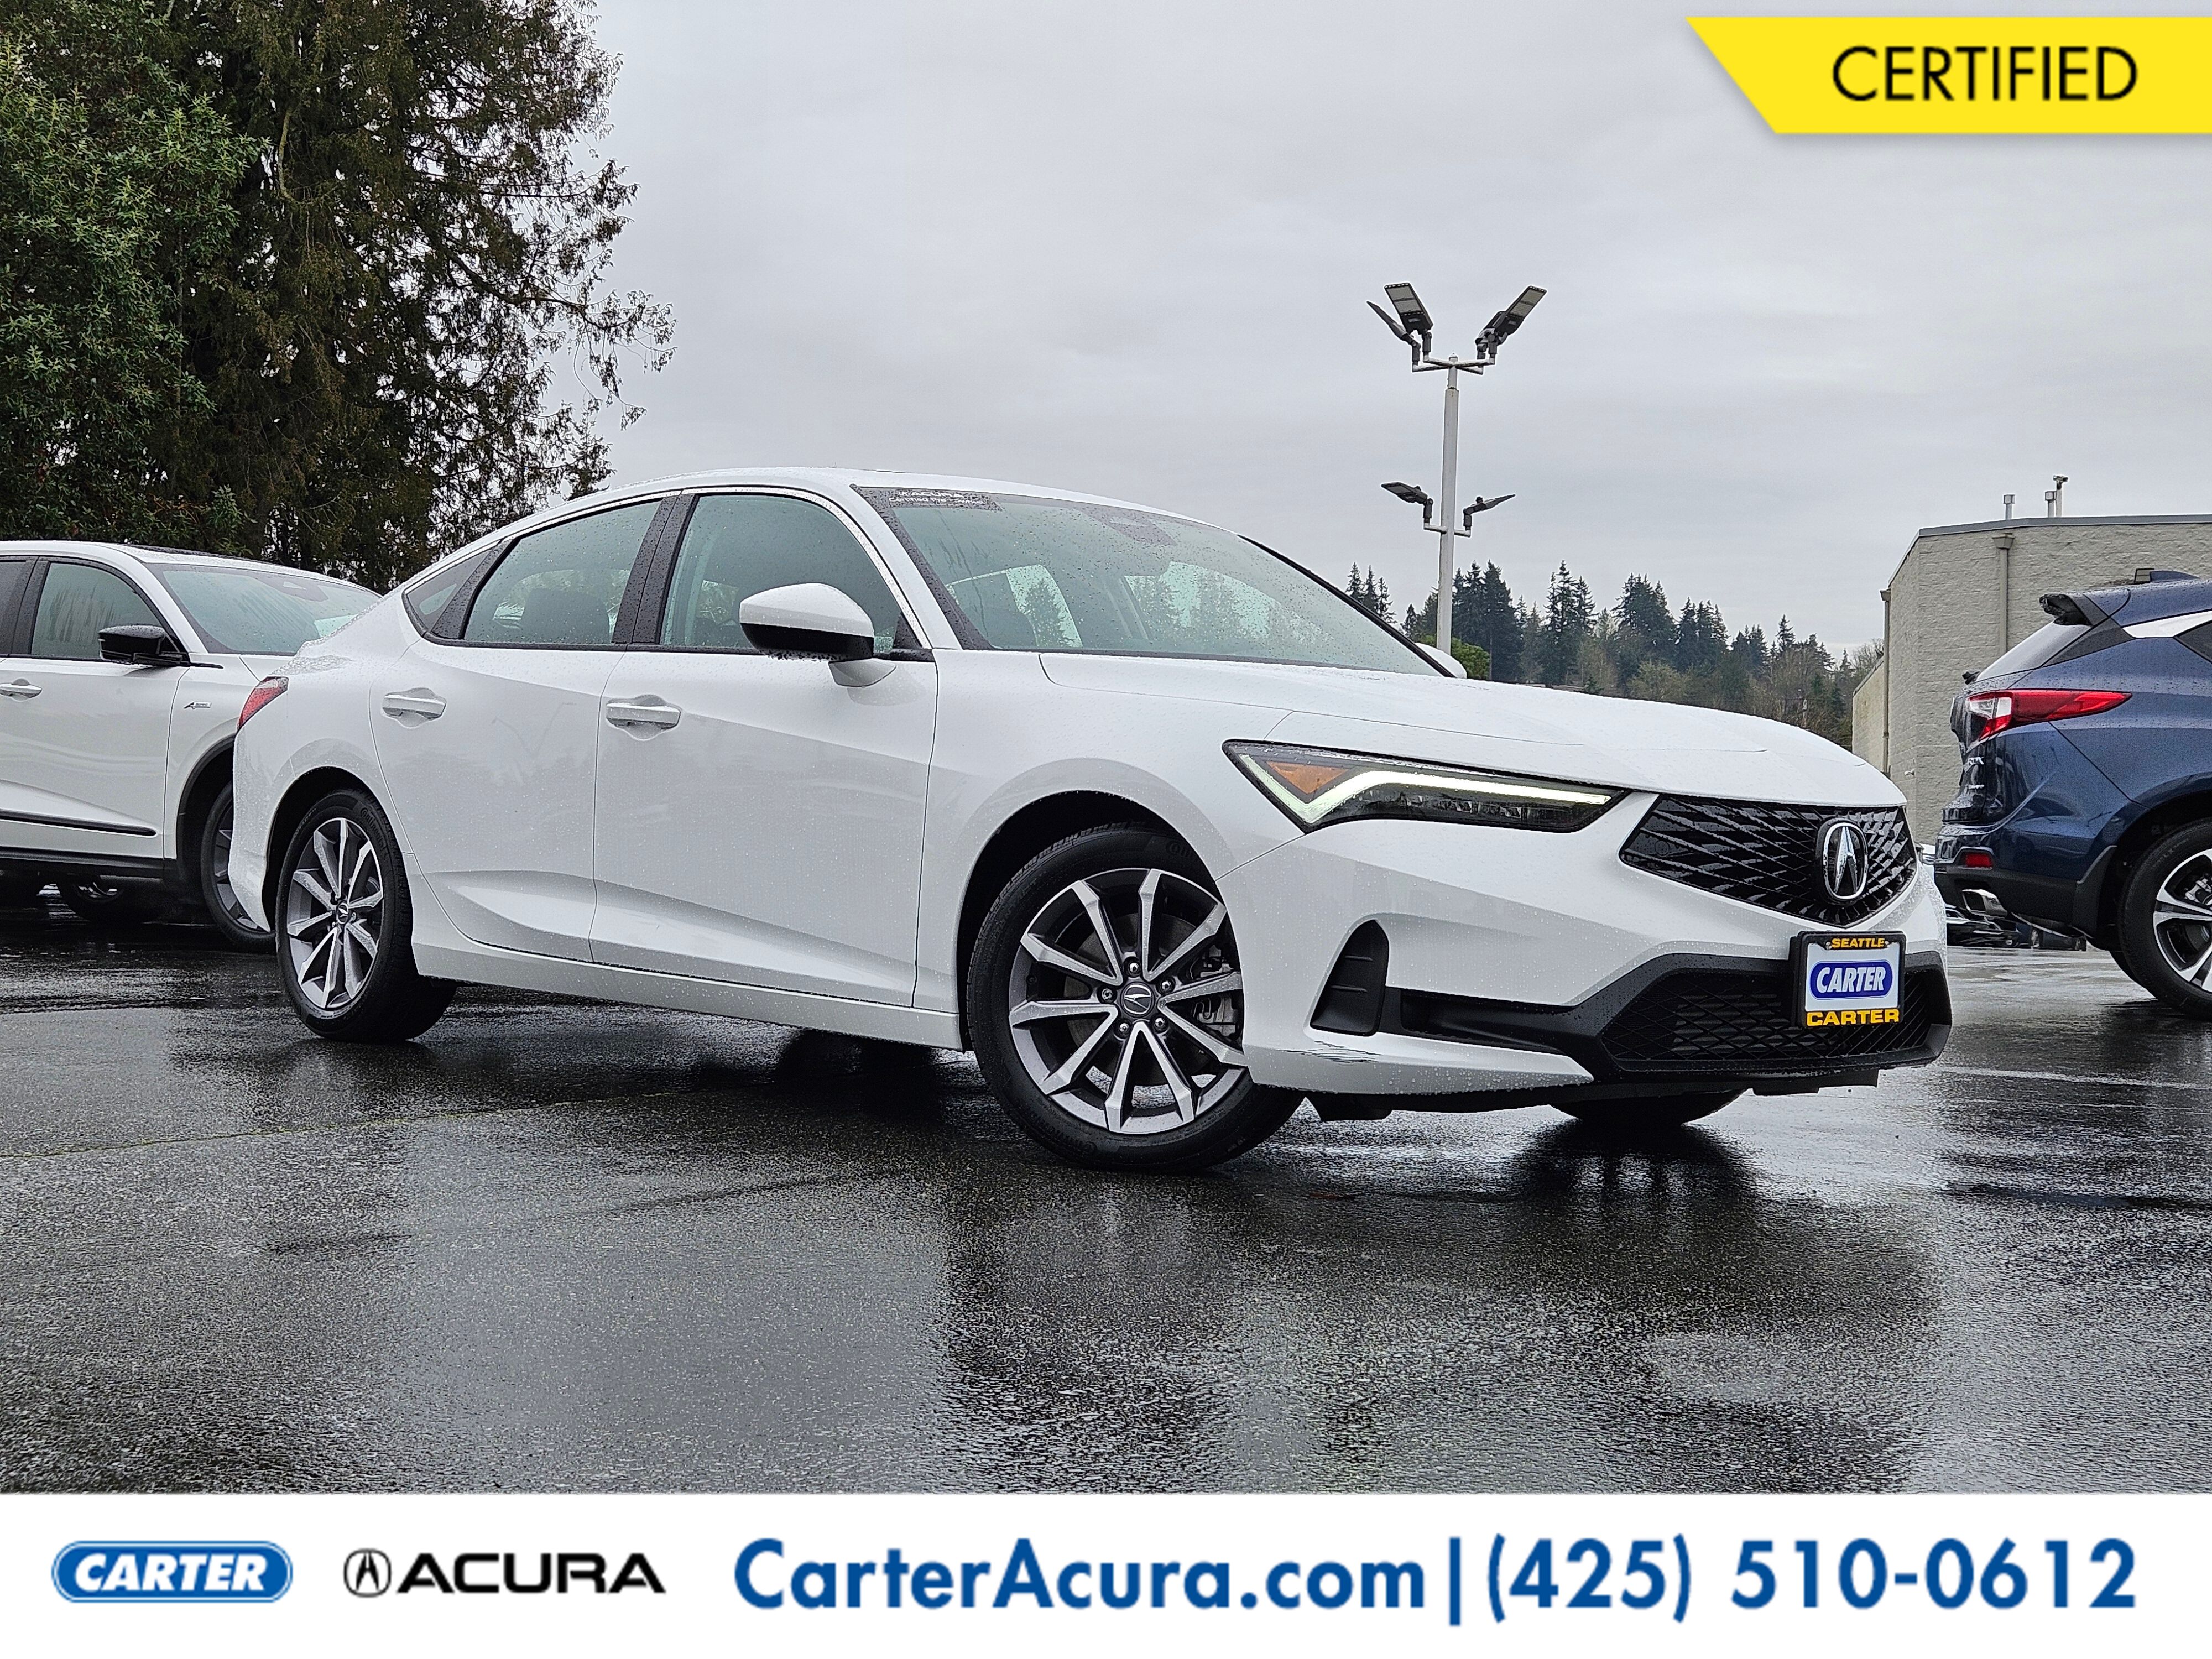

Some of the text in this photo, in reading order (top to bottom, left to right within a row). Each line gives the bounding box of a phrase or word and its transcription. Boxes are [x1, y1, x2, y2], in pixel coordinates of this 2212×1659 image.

[1831, 937, 1885, 949] SEATTLE
[1816, 966, 1886, 993] CARTER
[1806, 1008, 1900, 1027] CARTER
